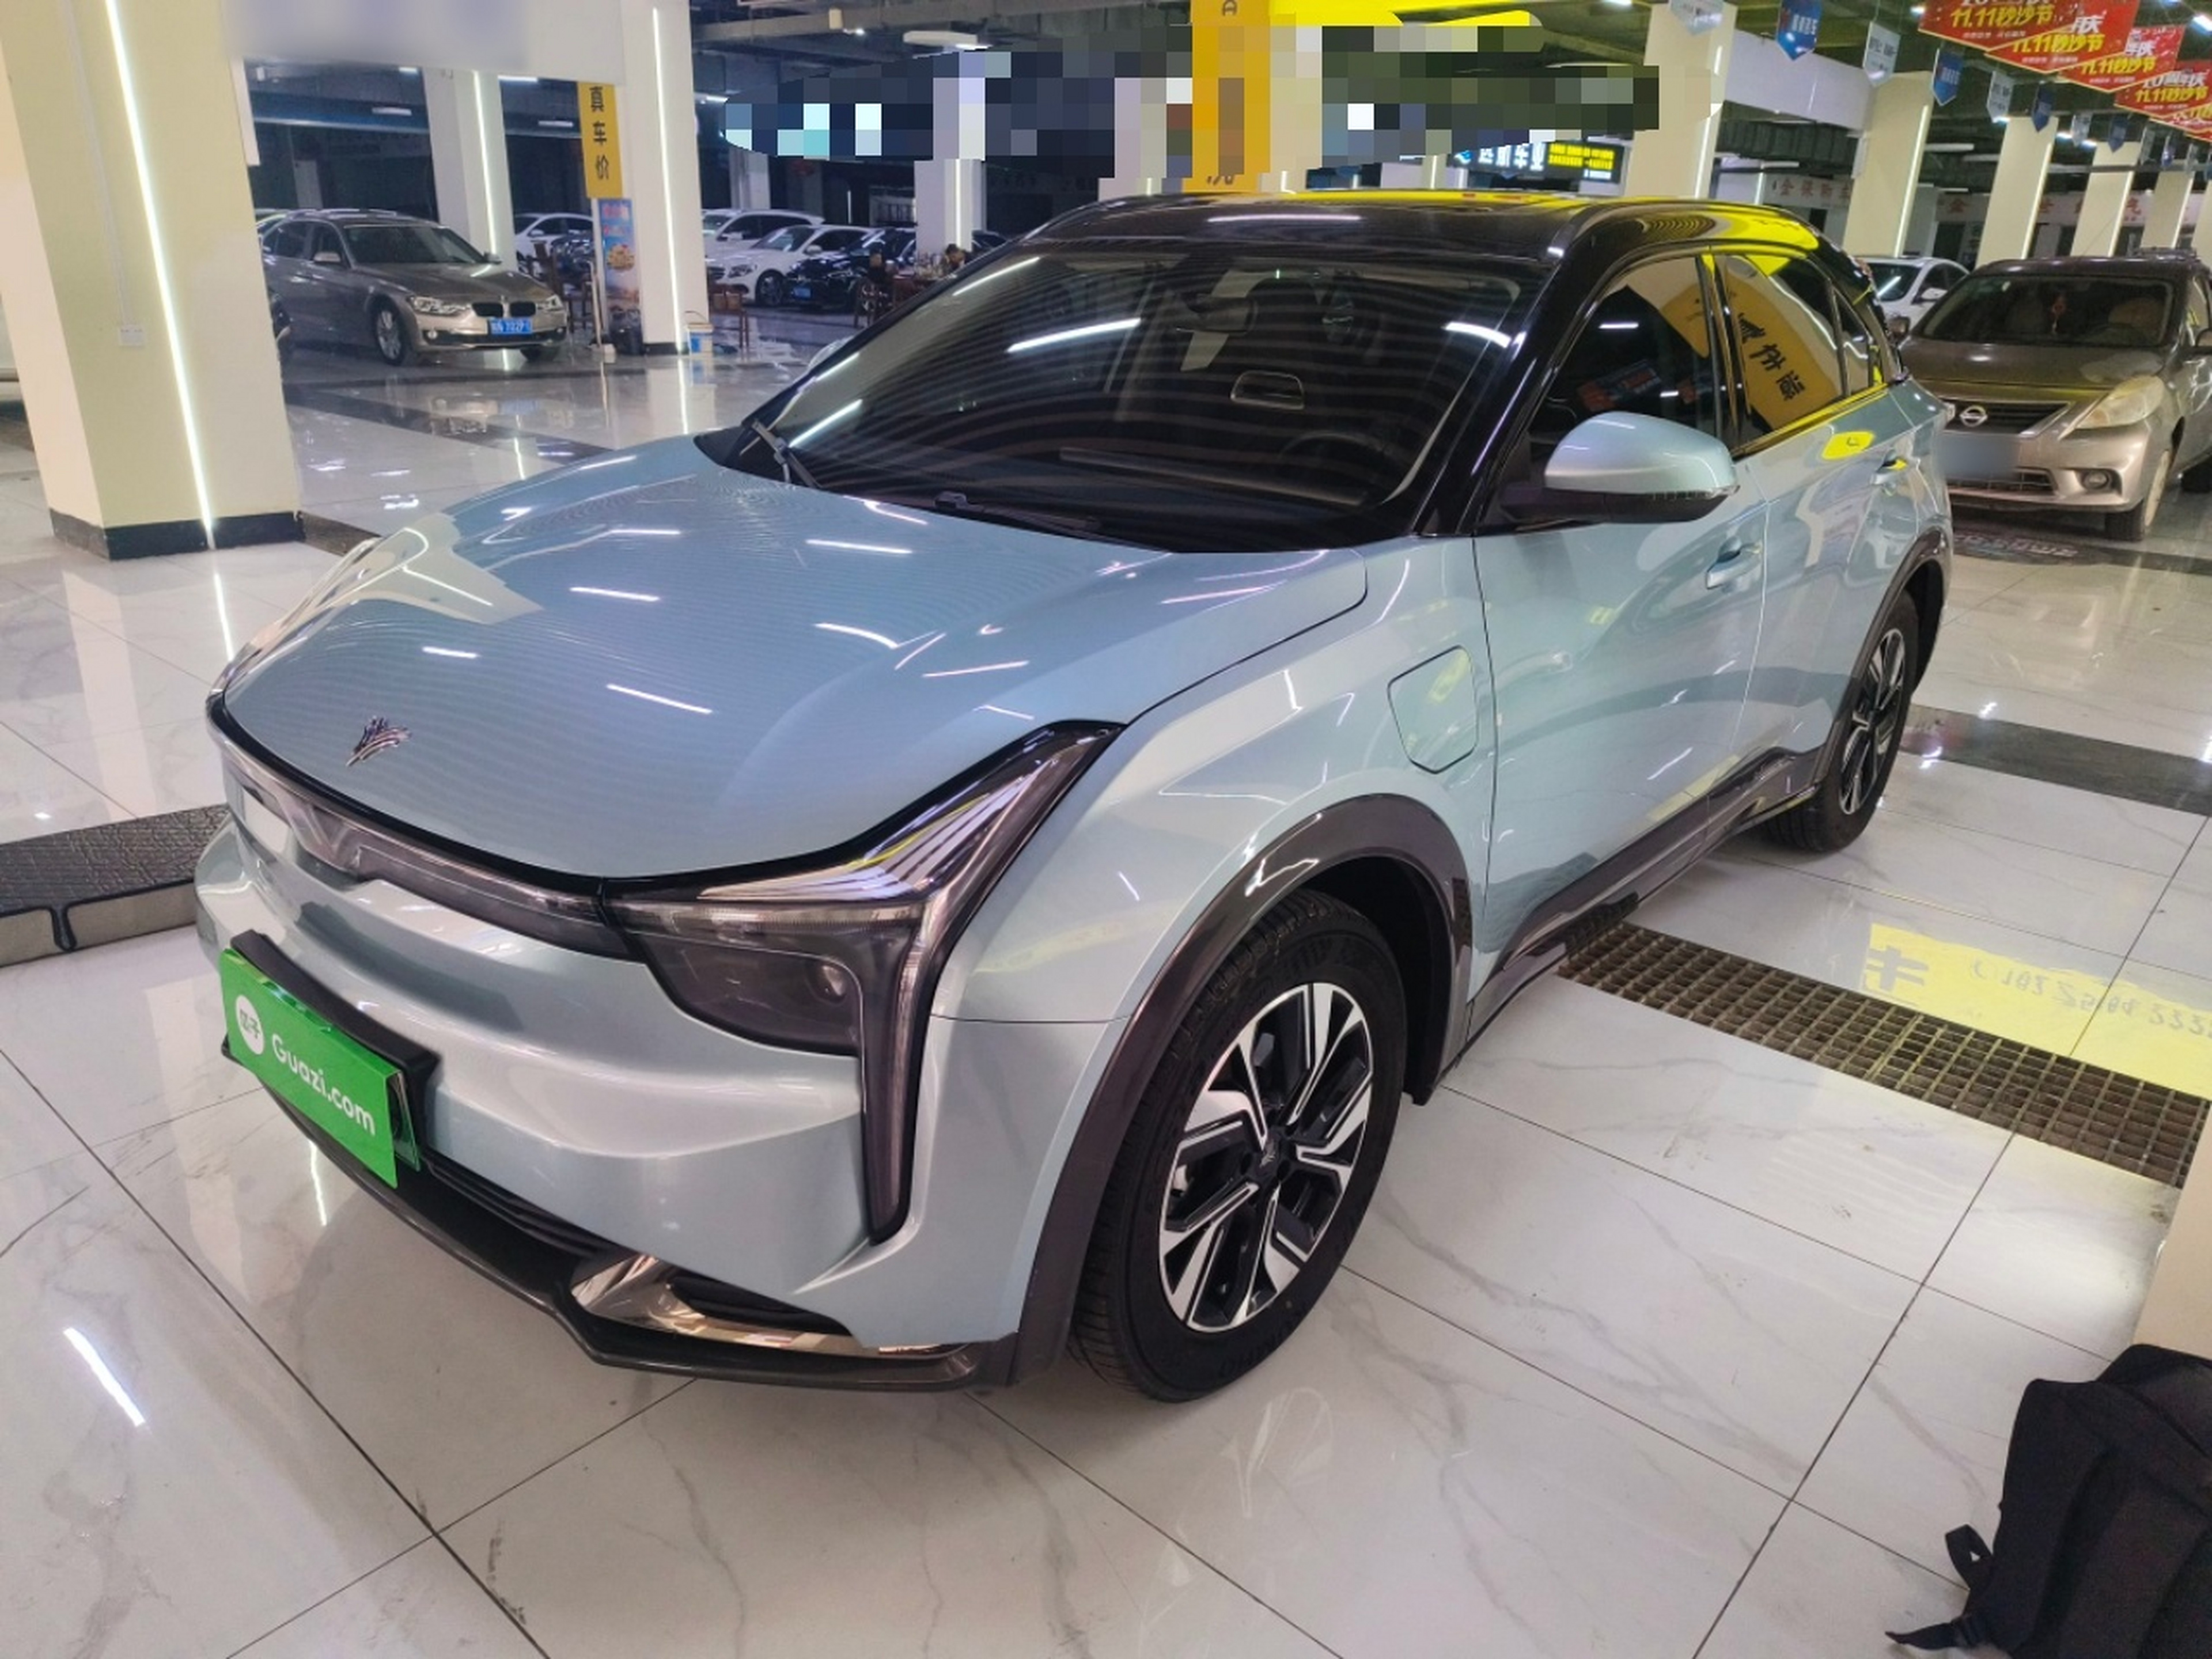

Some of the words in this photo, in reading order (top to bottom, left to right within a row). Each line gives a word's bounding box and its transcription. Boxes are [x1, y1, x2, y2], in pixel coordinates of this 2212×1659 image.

[589, 86, 610, 180] 真车价
[271, 1034, 376, 1137] Guazi.com
